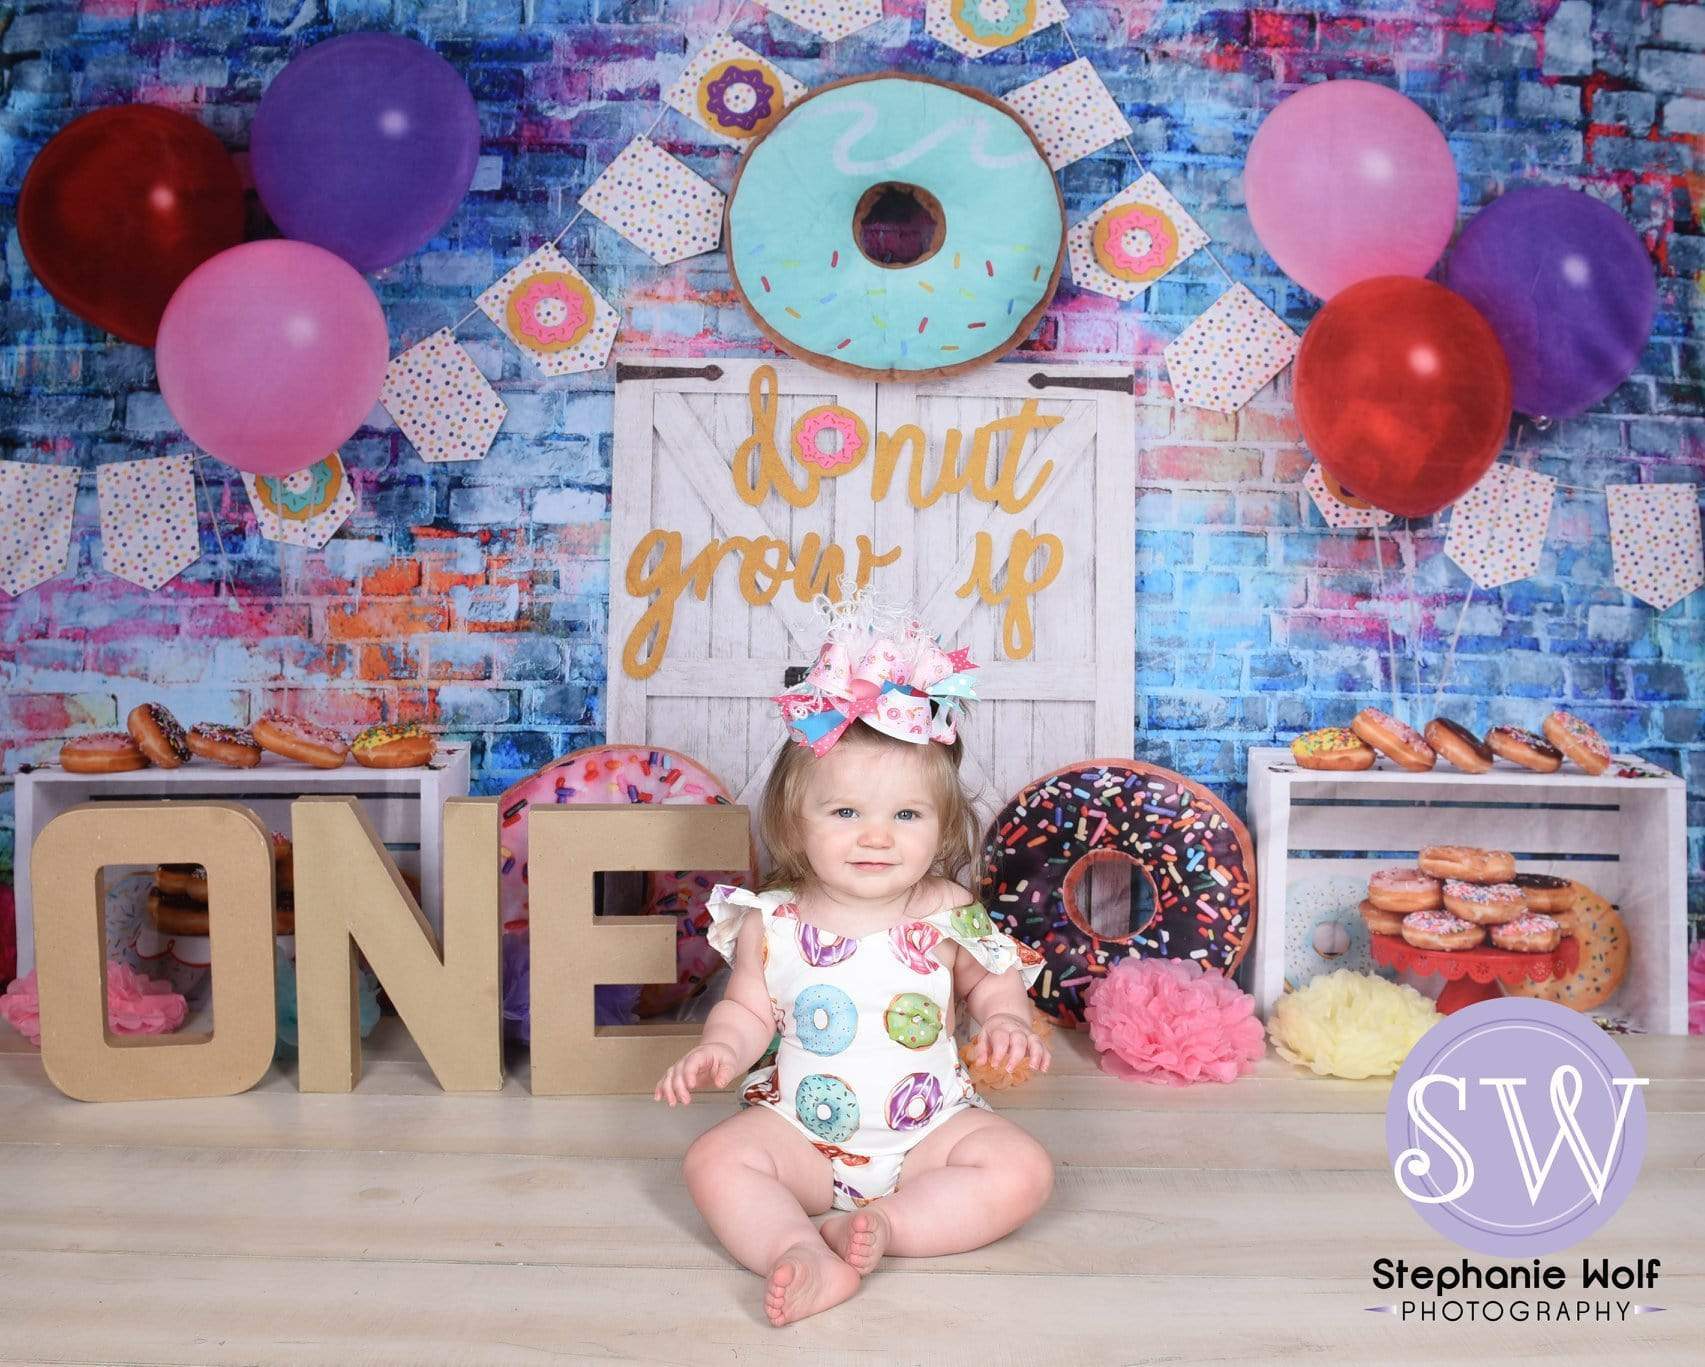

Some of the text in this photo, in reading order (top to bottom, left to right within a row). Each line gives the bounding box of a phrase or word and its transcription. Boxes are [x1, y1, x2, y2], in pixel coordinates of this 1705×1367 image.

[732, 364, 1065, 514] donut
[622, 529, 902, 680] grow
[30, 795, 750, 1102] ONE
